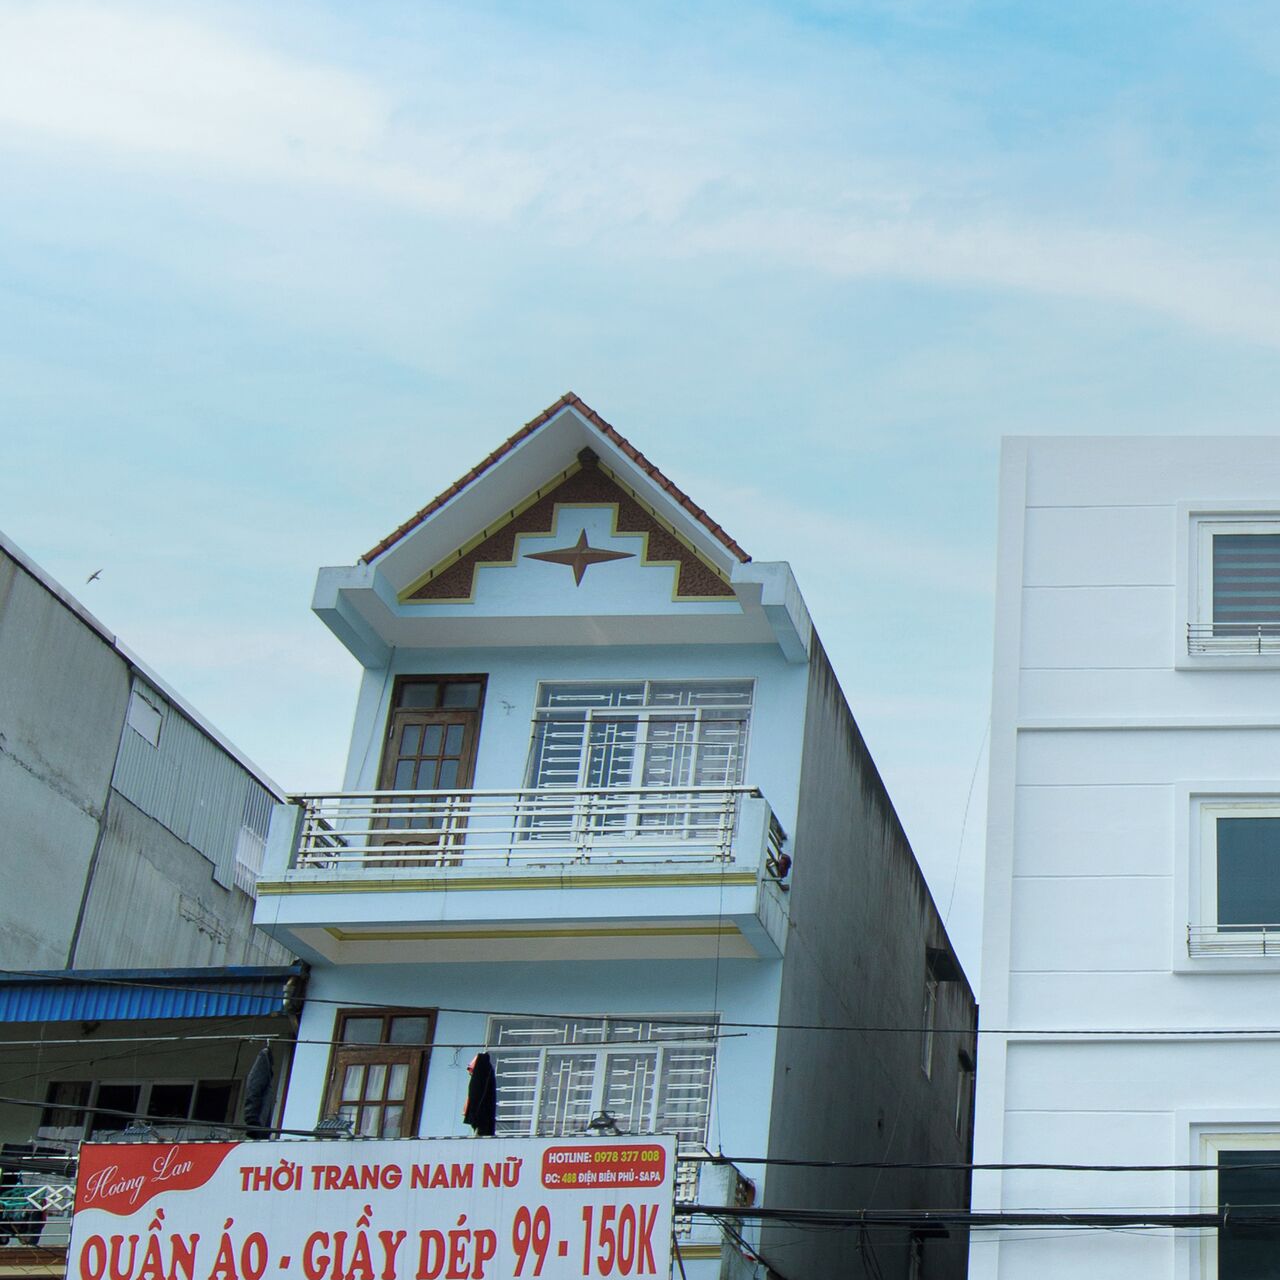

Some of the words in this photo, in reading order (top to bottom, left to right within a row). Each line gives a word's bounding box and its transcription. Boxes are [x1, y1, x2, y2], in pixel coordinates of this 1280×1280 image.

[548, 1152, 592, 1163] HOTLINE:
[594, 1151, 618, 1163] 0978
[620, 1150, 639, 1162] 377
[641, 1150, 660, 1161] 008
[83, 1165, 145, 1205] Hoàng
[151, 1145, 193, 1182] Lan
[240, 1158, 303, 1192] THỜI
[311, 1164, 402, 1191] TRANG
[410, 1163, 474, 1189] NAM
[482, 1157, 523, 1188] NỮ
[578, 1170, 597, 1185] ĐIỆN
[598, 1170, 616, 1182] BIÊN
[415, 1213, 497, 1280] DÉP
[512, 1205, 551, 1277] 99
[582, 1203, 660, 1277] 150K
